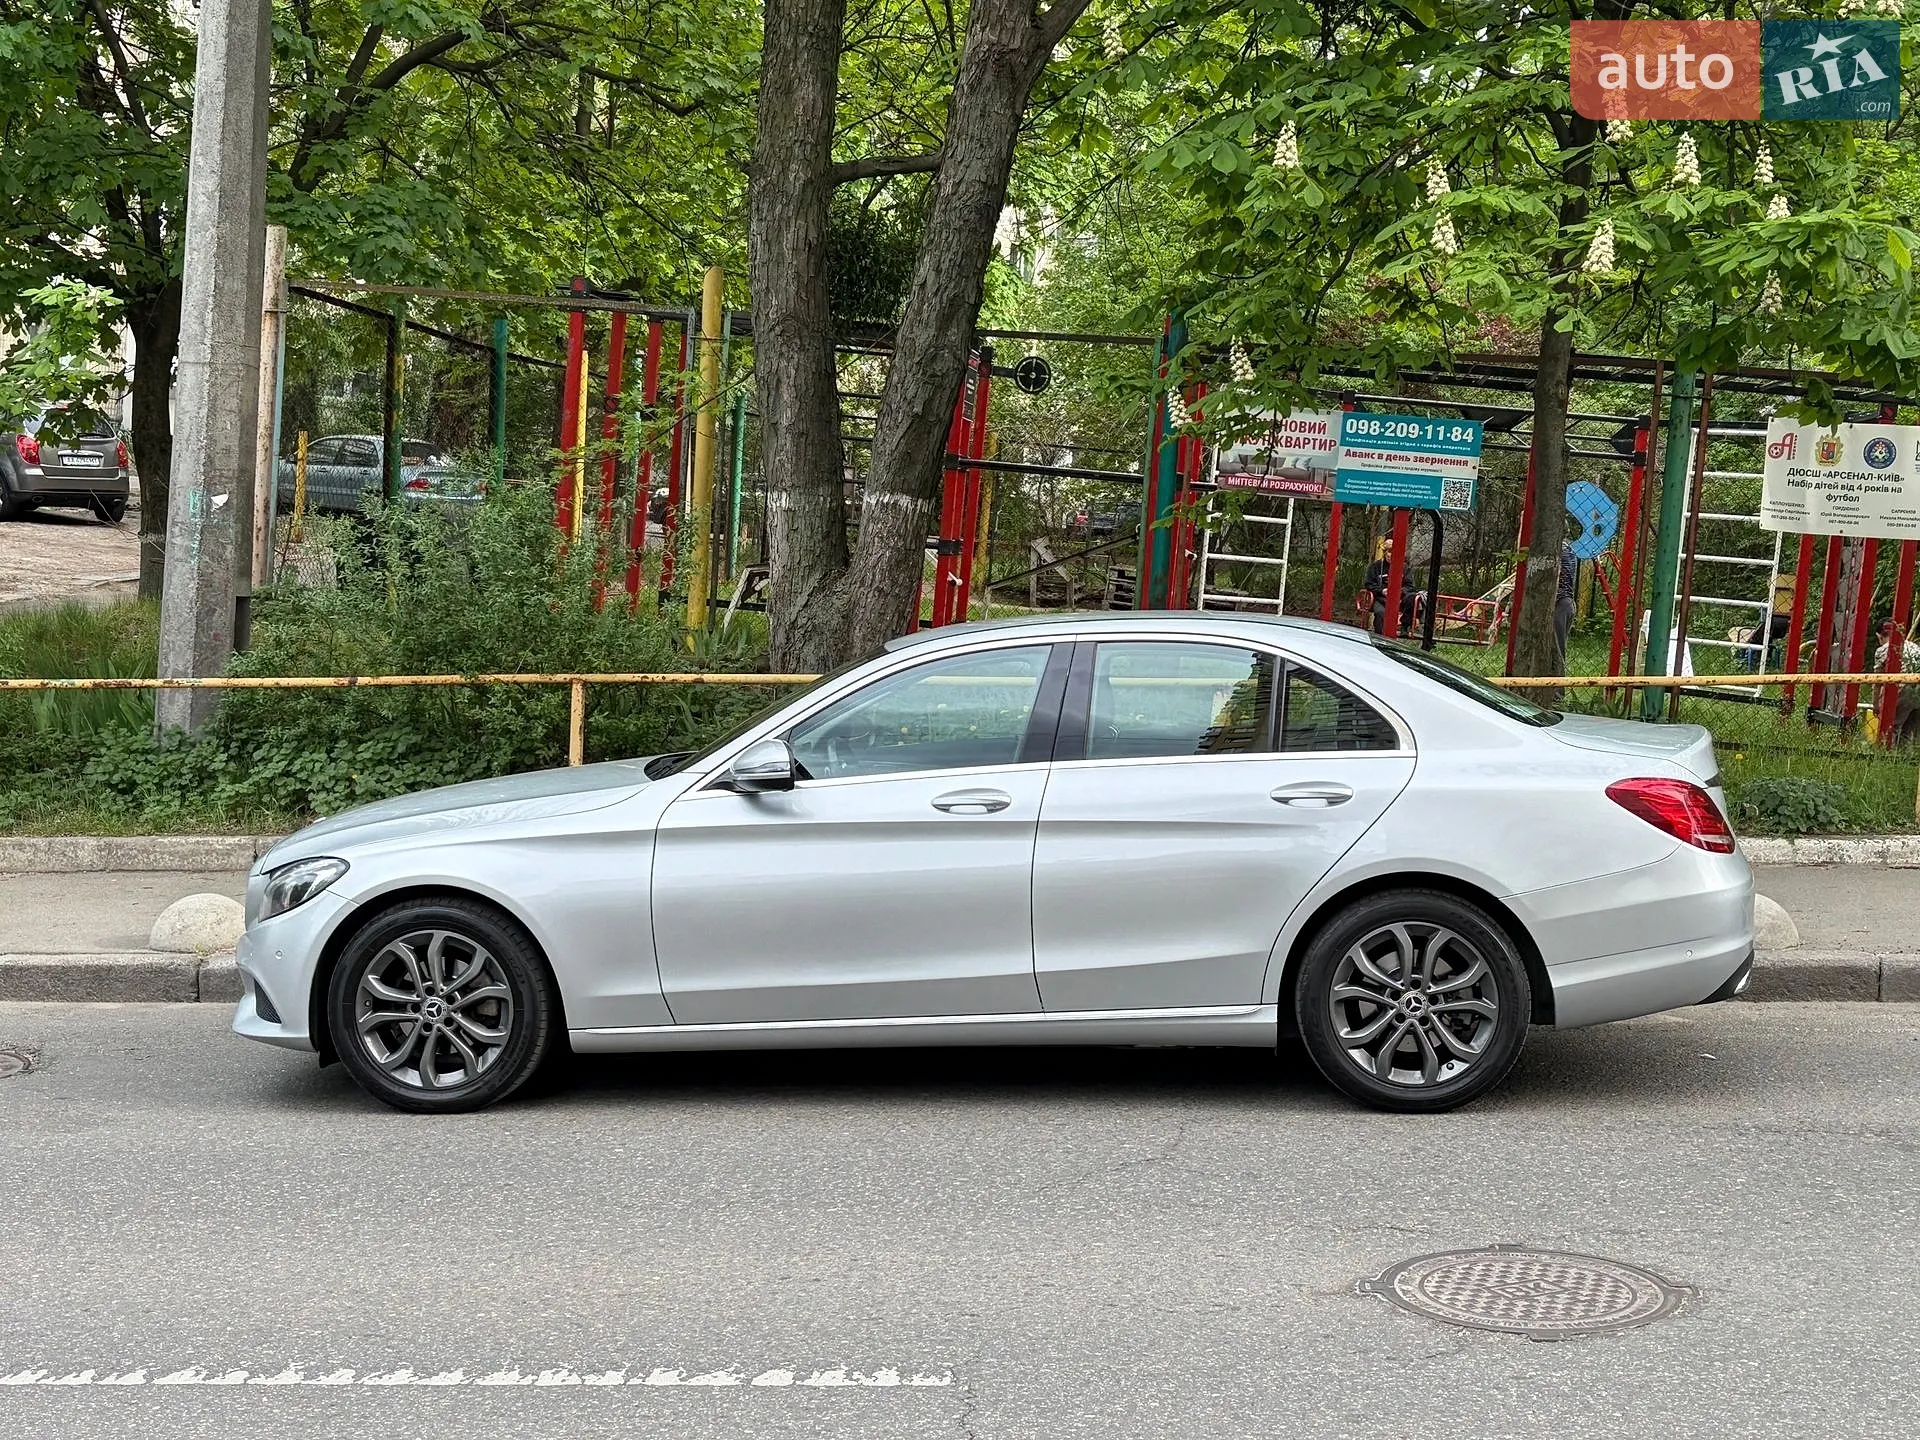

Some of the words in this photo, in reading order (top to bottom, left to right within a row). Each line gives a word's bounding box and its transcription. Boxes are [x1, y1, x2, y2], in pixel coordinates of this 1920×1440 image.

[1345, 448, 1376, 460] Аванс
[1386, 453, 1411, 464] день
[1413, 455, 1469, 467] звернення
[1787, 468, 1821, 477] ДЮСШ
[1823, 470, 1905, 482] «АРСЕНАЛ-КИЇВ»
[1269, 480, 1323, 493] РОЗРАХУНОК!
[1787, 479, 1813, 489] Набір
[1814, 481, 1839, 490] дітей
[1841, 483, 1855, 492] від
[1856, 483, 1862, 491] 4
[1864, 484, 1889, 493] років
[1825, 493, 1860, 502] футбол
